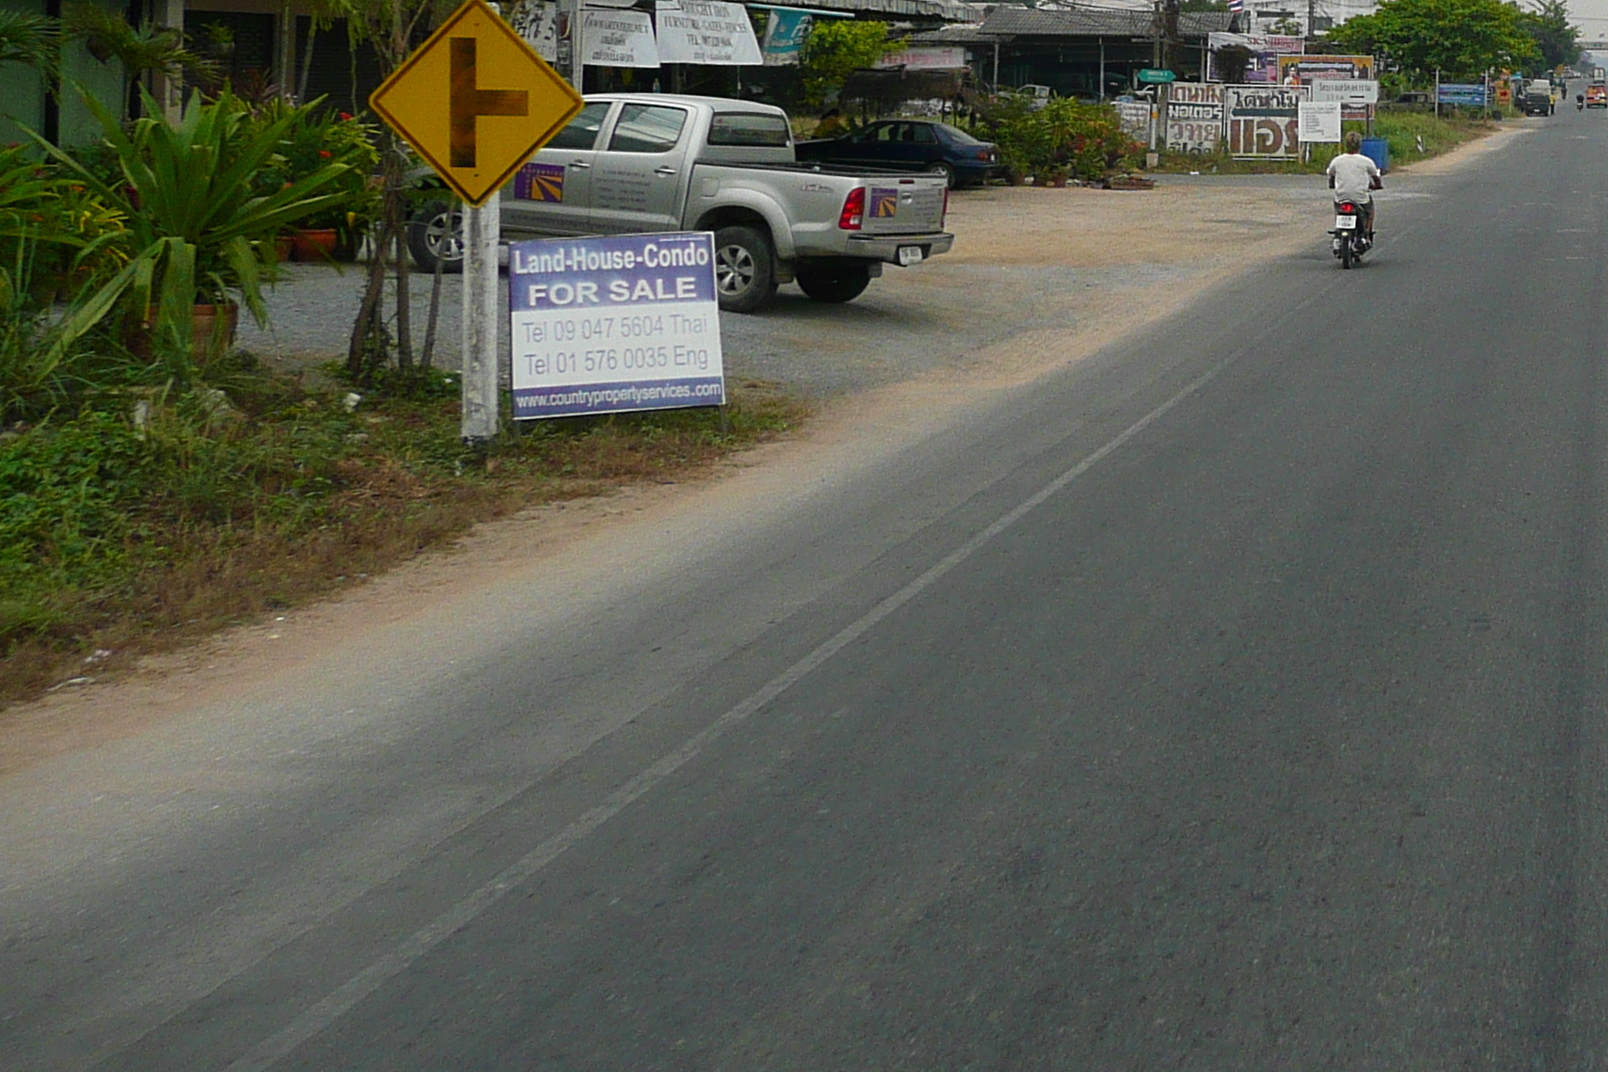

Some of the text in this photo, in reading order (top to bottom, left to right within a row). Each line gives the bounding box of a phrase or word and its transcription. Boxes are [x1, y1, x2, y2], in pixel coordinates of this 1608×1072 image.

[514, 242, 709, 274] Land-House-Condo
[528, 276, 697, 307] FOR SALE
[521, 313, 708, 343] Tel 09 047 5604 Thai
[524, 345, 709, 375] Tel 01 576 0035 Eng
[516, 382, 721, 408] www.countrypropertyservices.com
